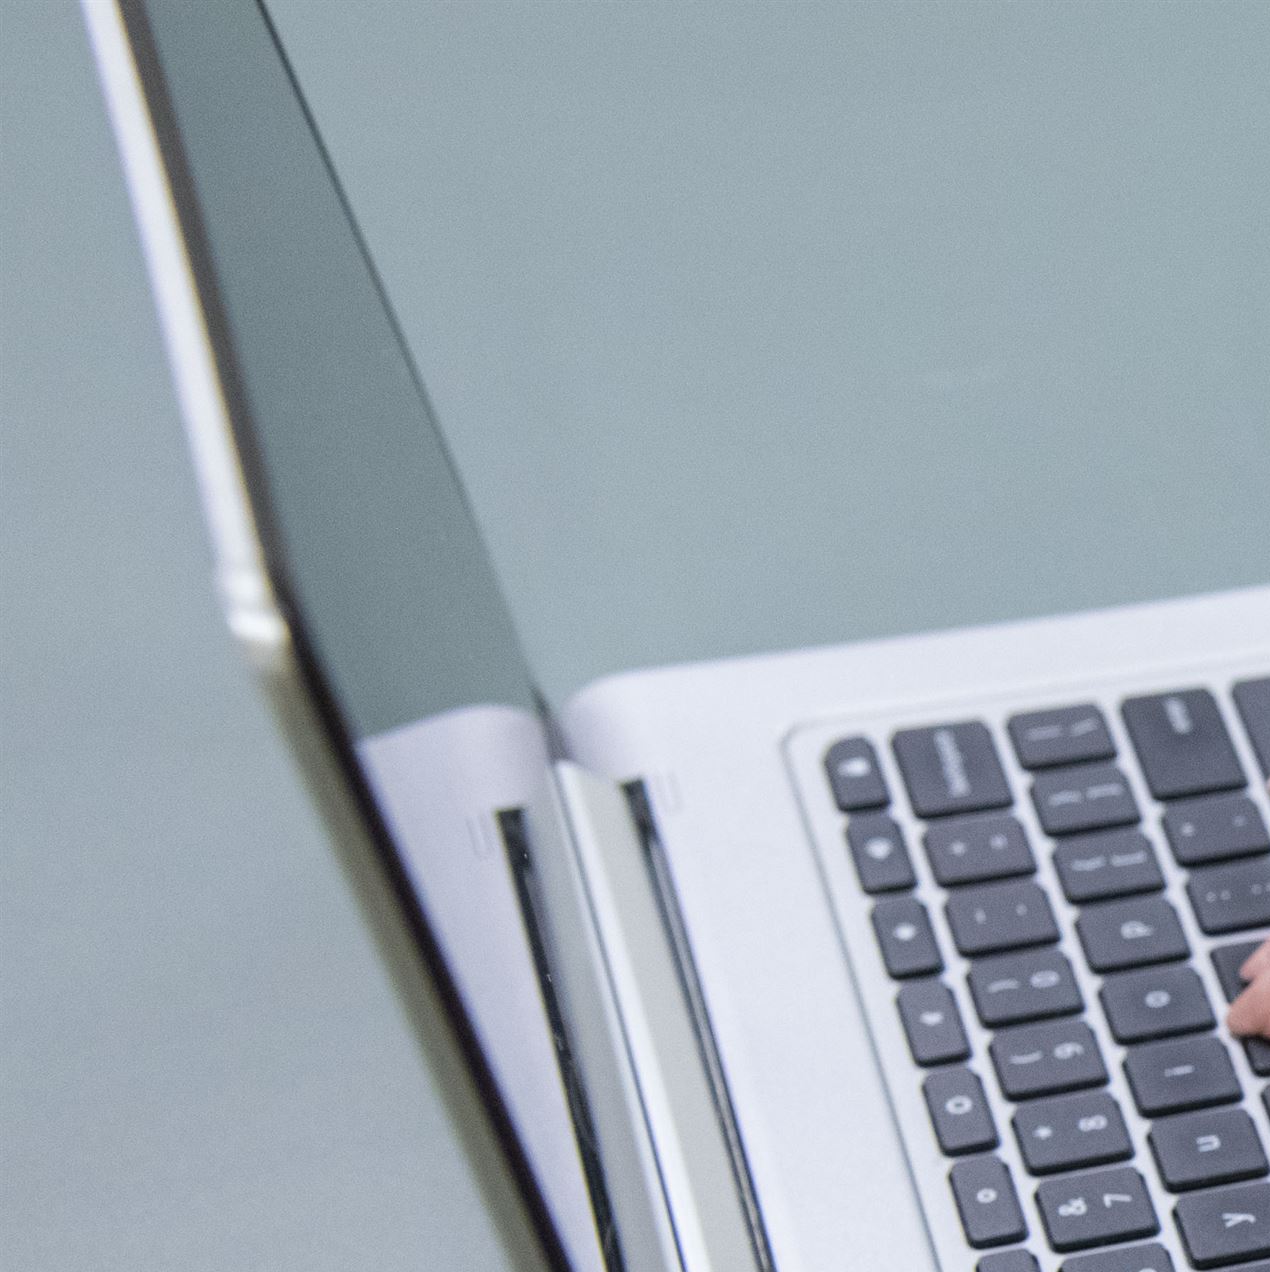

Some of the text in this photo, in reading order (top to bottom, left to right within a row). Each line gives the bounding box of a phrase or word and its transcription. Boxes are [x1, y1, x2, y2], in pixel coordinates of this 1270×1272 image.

[1055, 1043, 1082, 1058] 9
[1079, 1116, 1107, 1131] 8
[1197, 1135, 1220, 1151] u
[1059, 1198, 1086, 1216] &
[1103, 1194, 1131, 1207] 7
[1224, 1214, 1255, 1227] y
